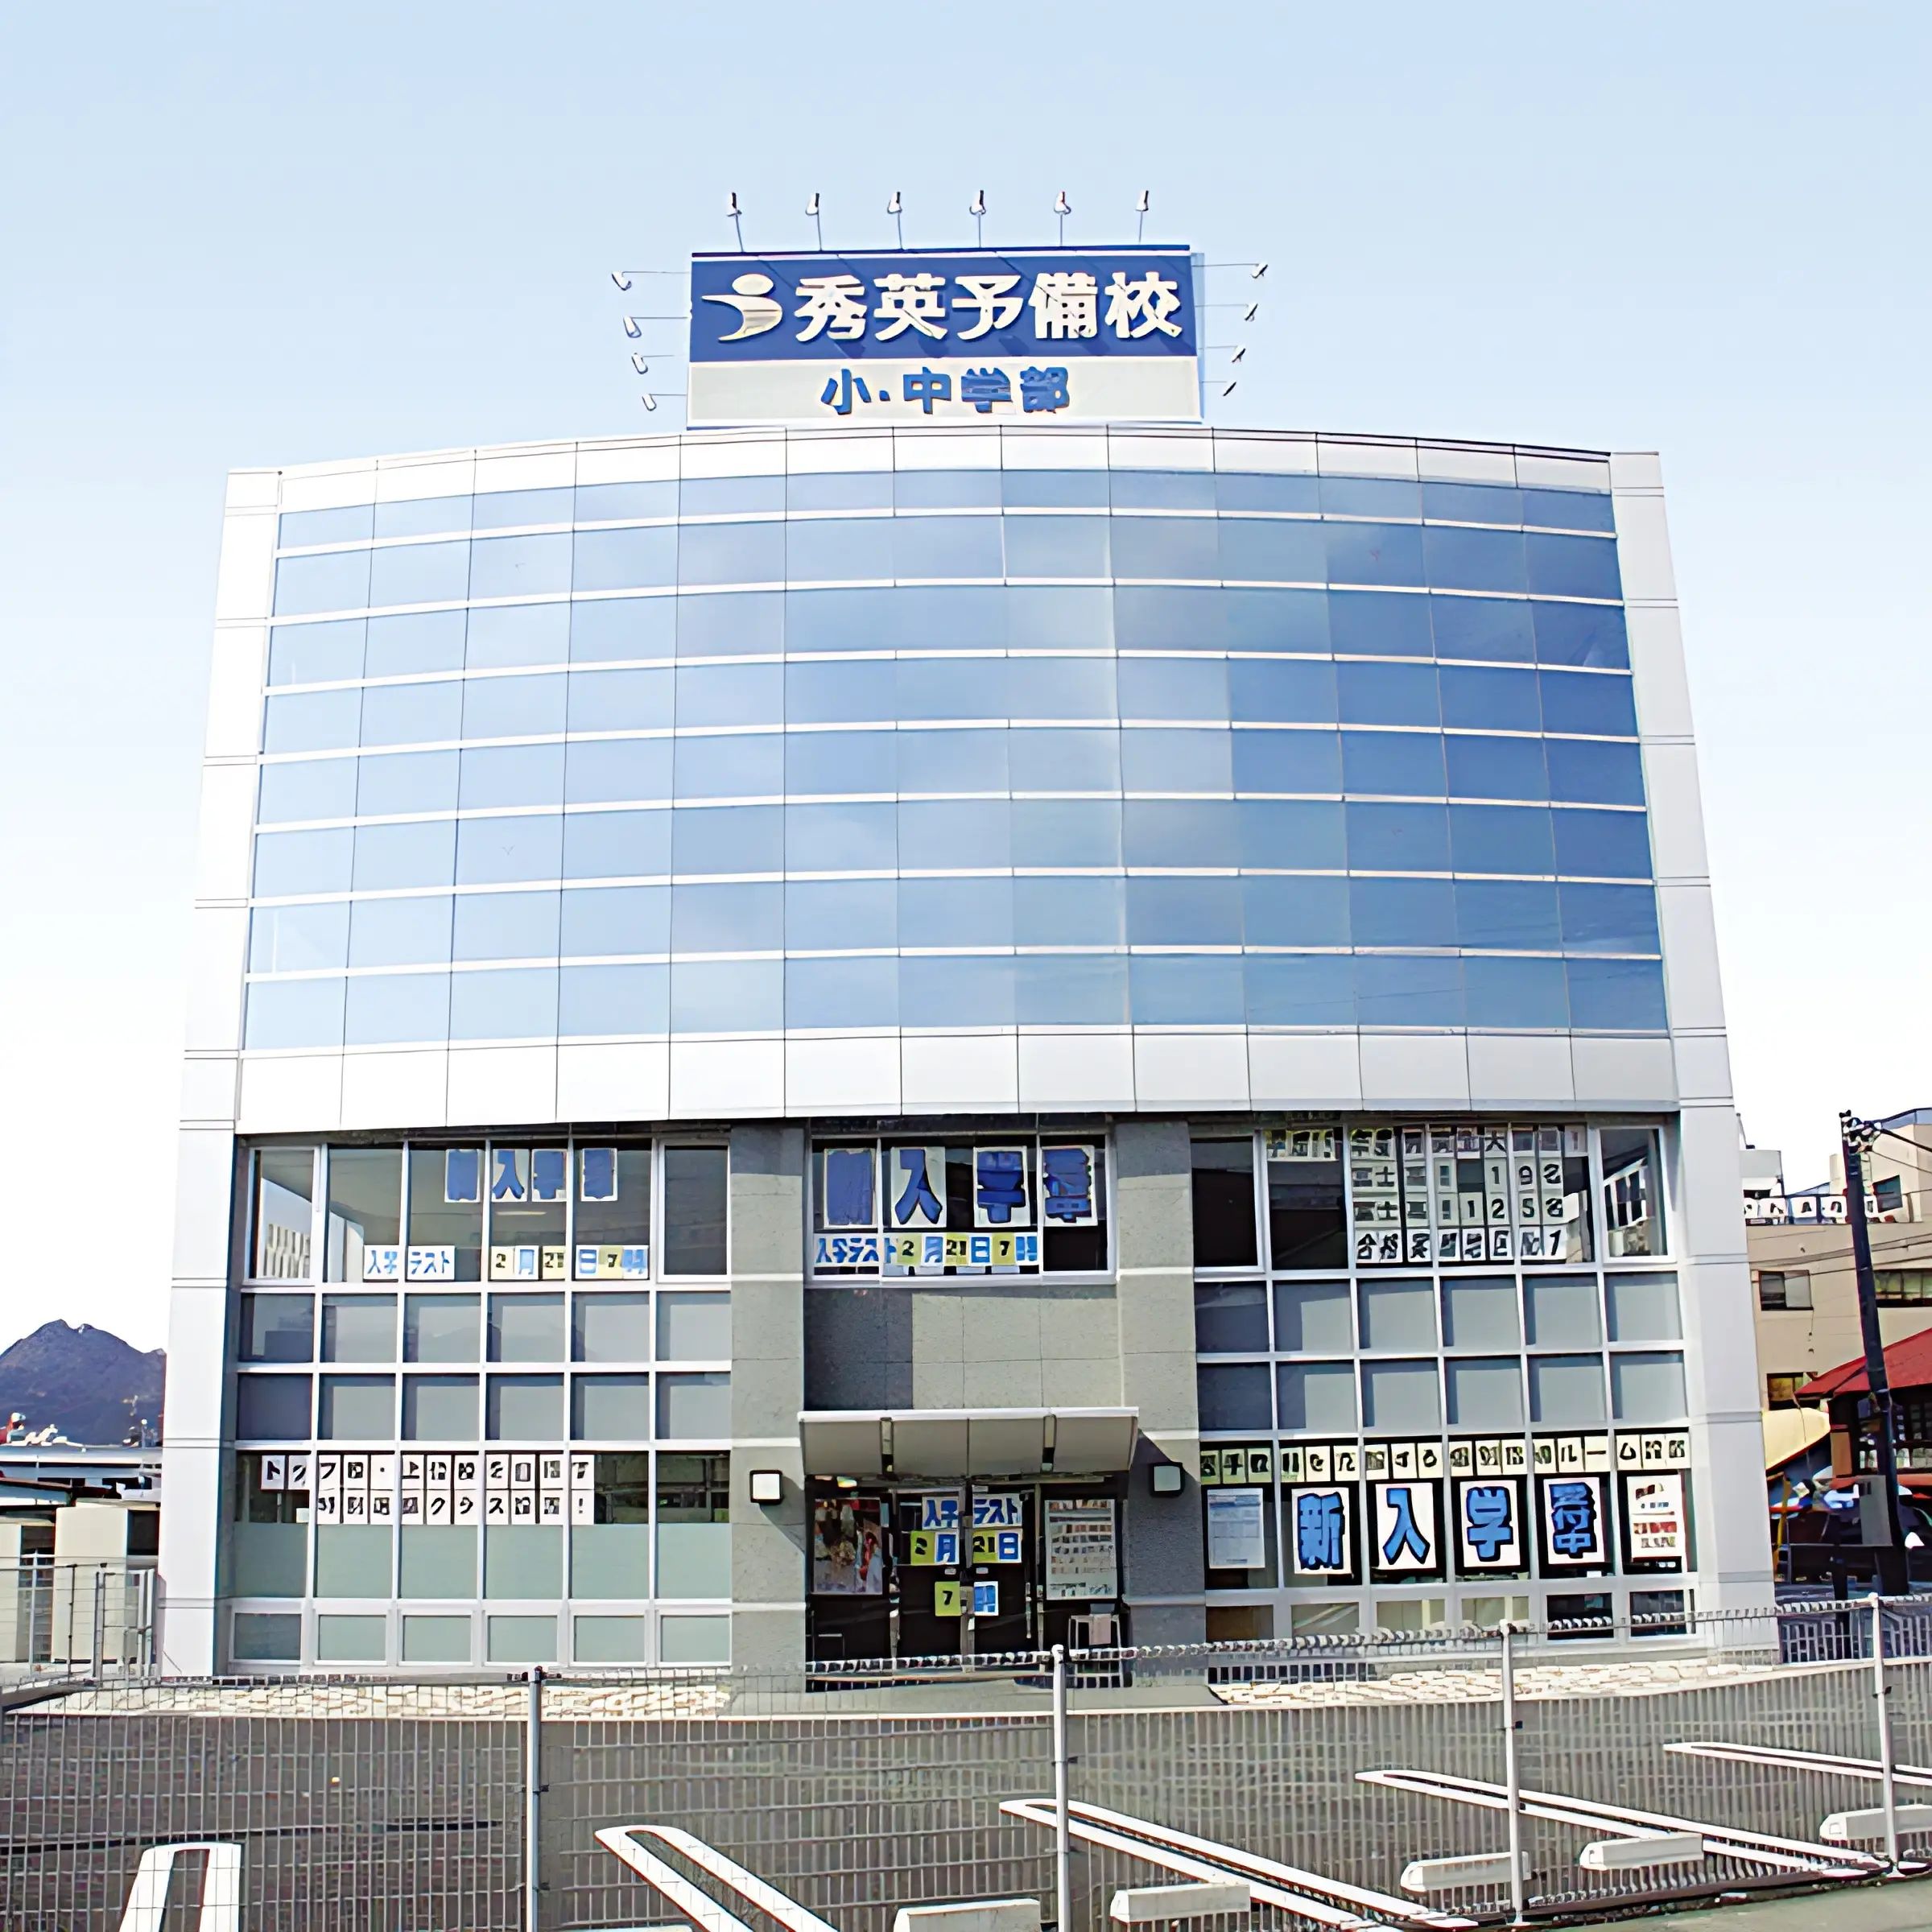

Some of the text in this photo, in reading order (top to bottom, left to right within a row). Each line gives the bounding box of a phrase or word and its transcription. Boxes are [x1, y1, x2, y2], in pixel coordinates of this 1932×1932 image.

[795, 271, 1183, 343] 秀英予備校
